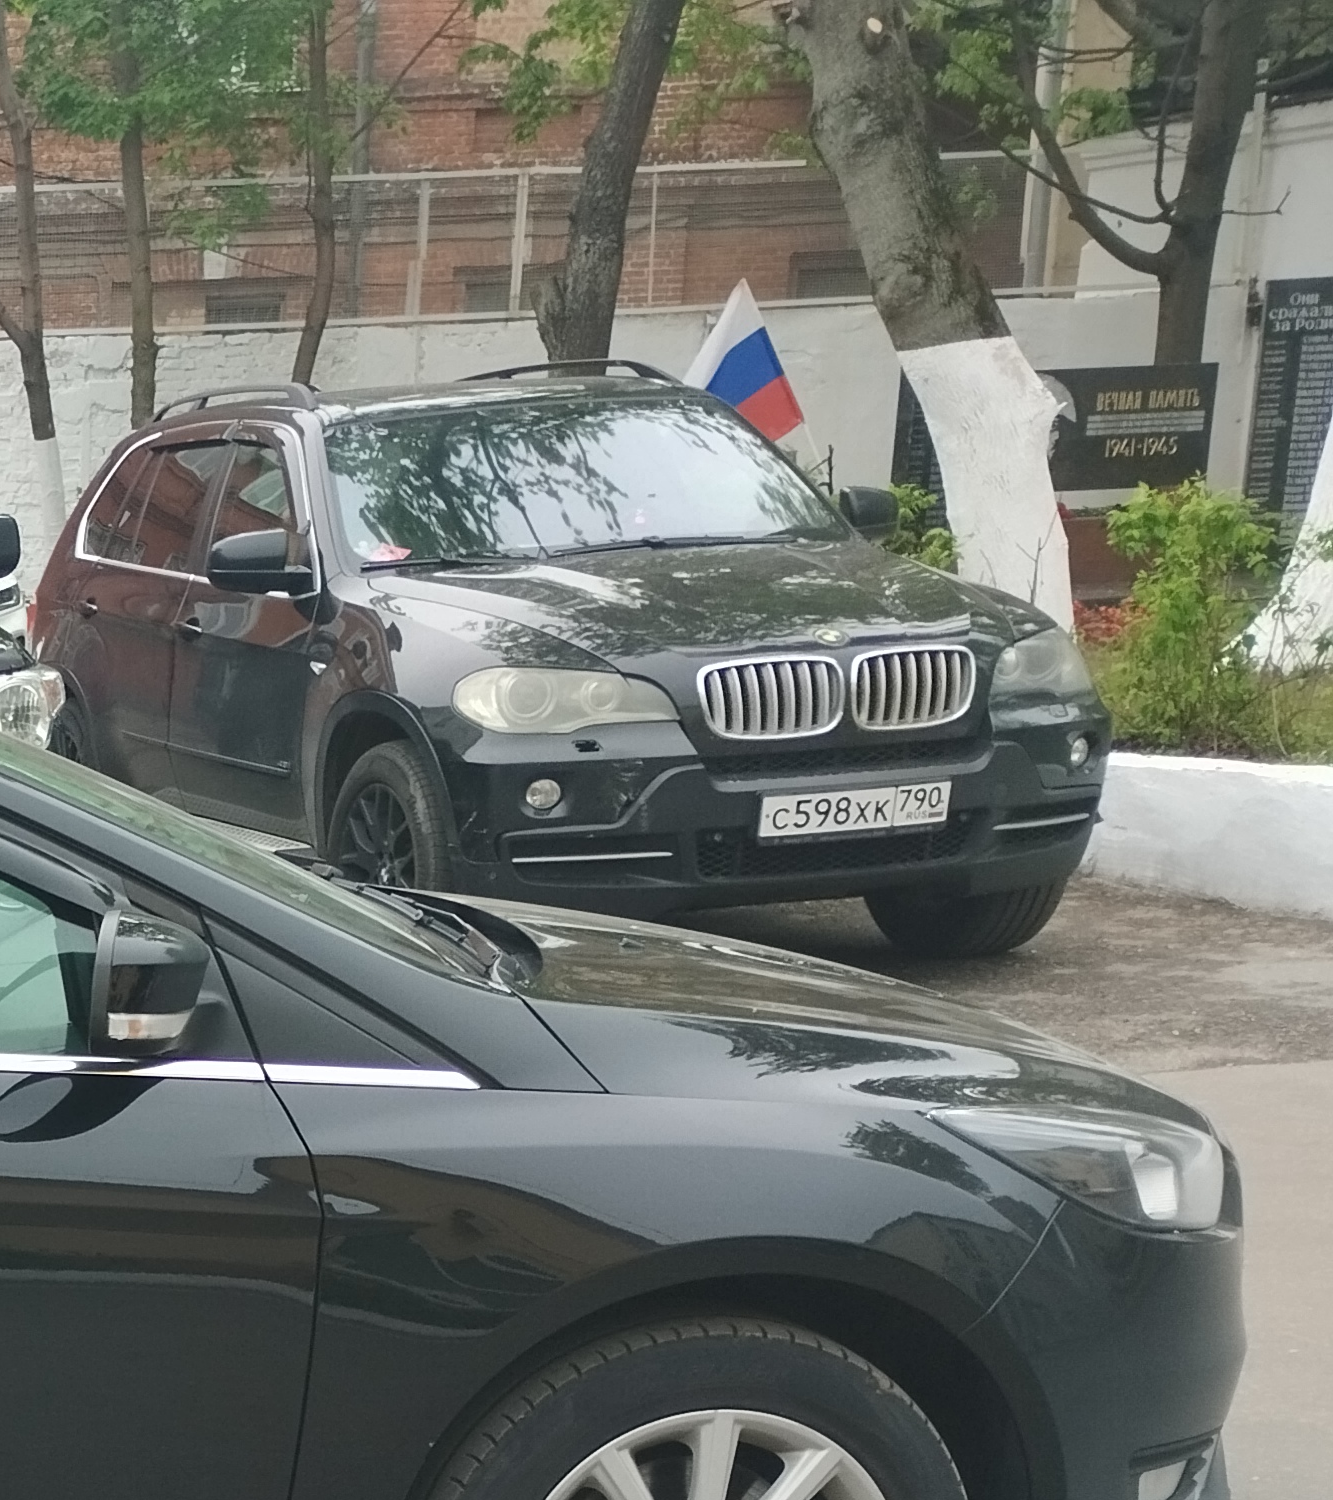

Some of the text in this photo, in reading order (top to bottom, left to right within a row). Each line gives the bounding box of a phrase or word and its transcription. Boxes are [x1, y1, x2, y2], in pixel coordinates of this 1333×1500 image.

[1096, 388, 1200, 411] ВЕЧНАЯ ПАМЯТЬ
[1104, 436, 1178, 458] 1941-1945
[899, 786, 942, 812] 790
[906, 810, 928, 820] RUS
